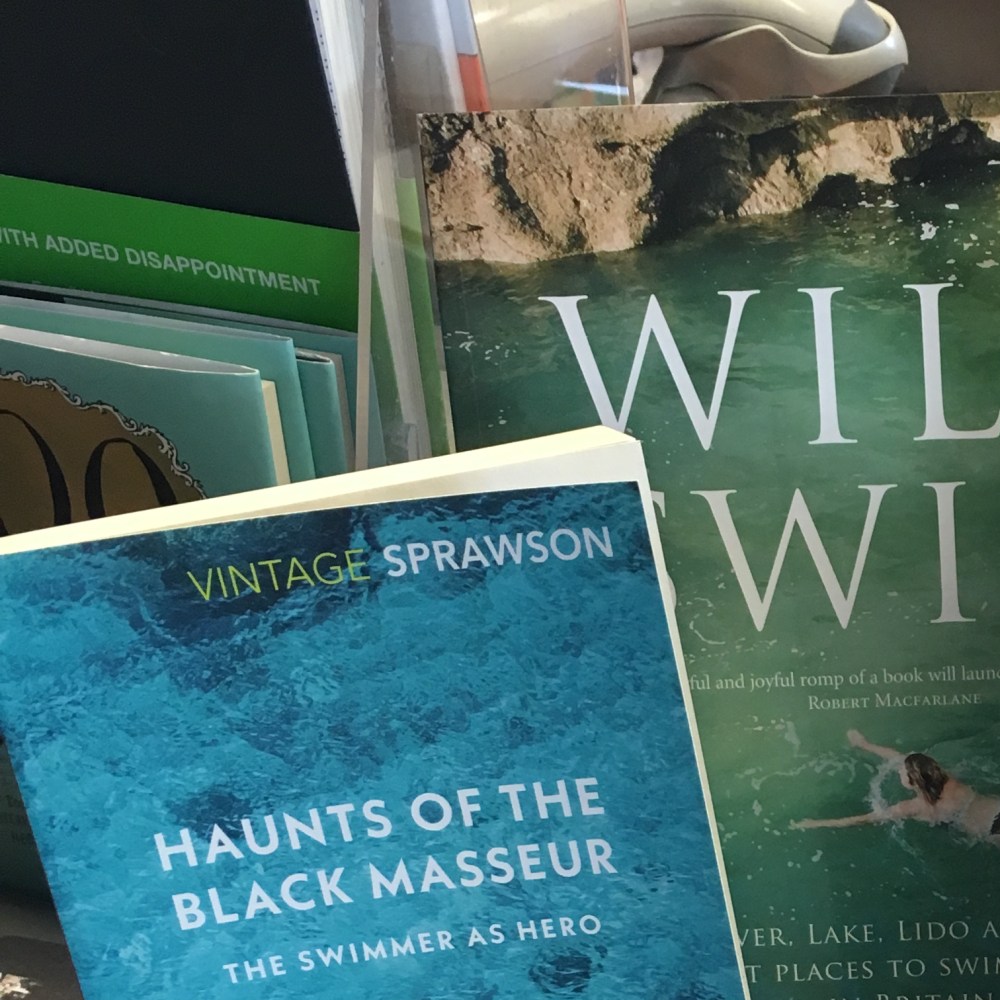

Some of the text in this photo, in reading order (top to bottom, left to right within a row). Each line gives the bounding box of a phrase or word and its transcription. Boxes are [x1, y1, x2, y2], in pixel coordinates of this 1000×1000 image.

[0, 226, 320, 296] ITH ADDED DISAPPOINTMENT
[187, 526, 614, 601] VINTAGE SPRAWSON
[715, 672, 745, 690] and
[750, 671, 795, 692] joyful
[801, 674, 844, 691] romp
[849, 669, 867, 685] of
[870, 673, 879, 684] a
[884, 665, 923, 684] book
[928, 665, 956, 682] will
[808, 695, 869, 711] ROBERT
[153, 777, 605, 871] HAUNTS OF THE
[171, 837, 618, 931] BLACK MASSEUR
[222, 914, 602, 984] THE SWIMMER AS HERO
[808, 923, 883, 945] LAKE,
[898, 920, 969, 942] LIDO
[775, 961, 874, 983] PLACES
[887, 958, 926, 978] TO
